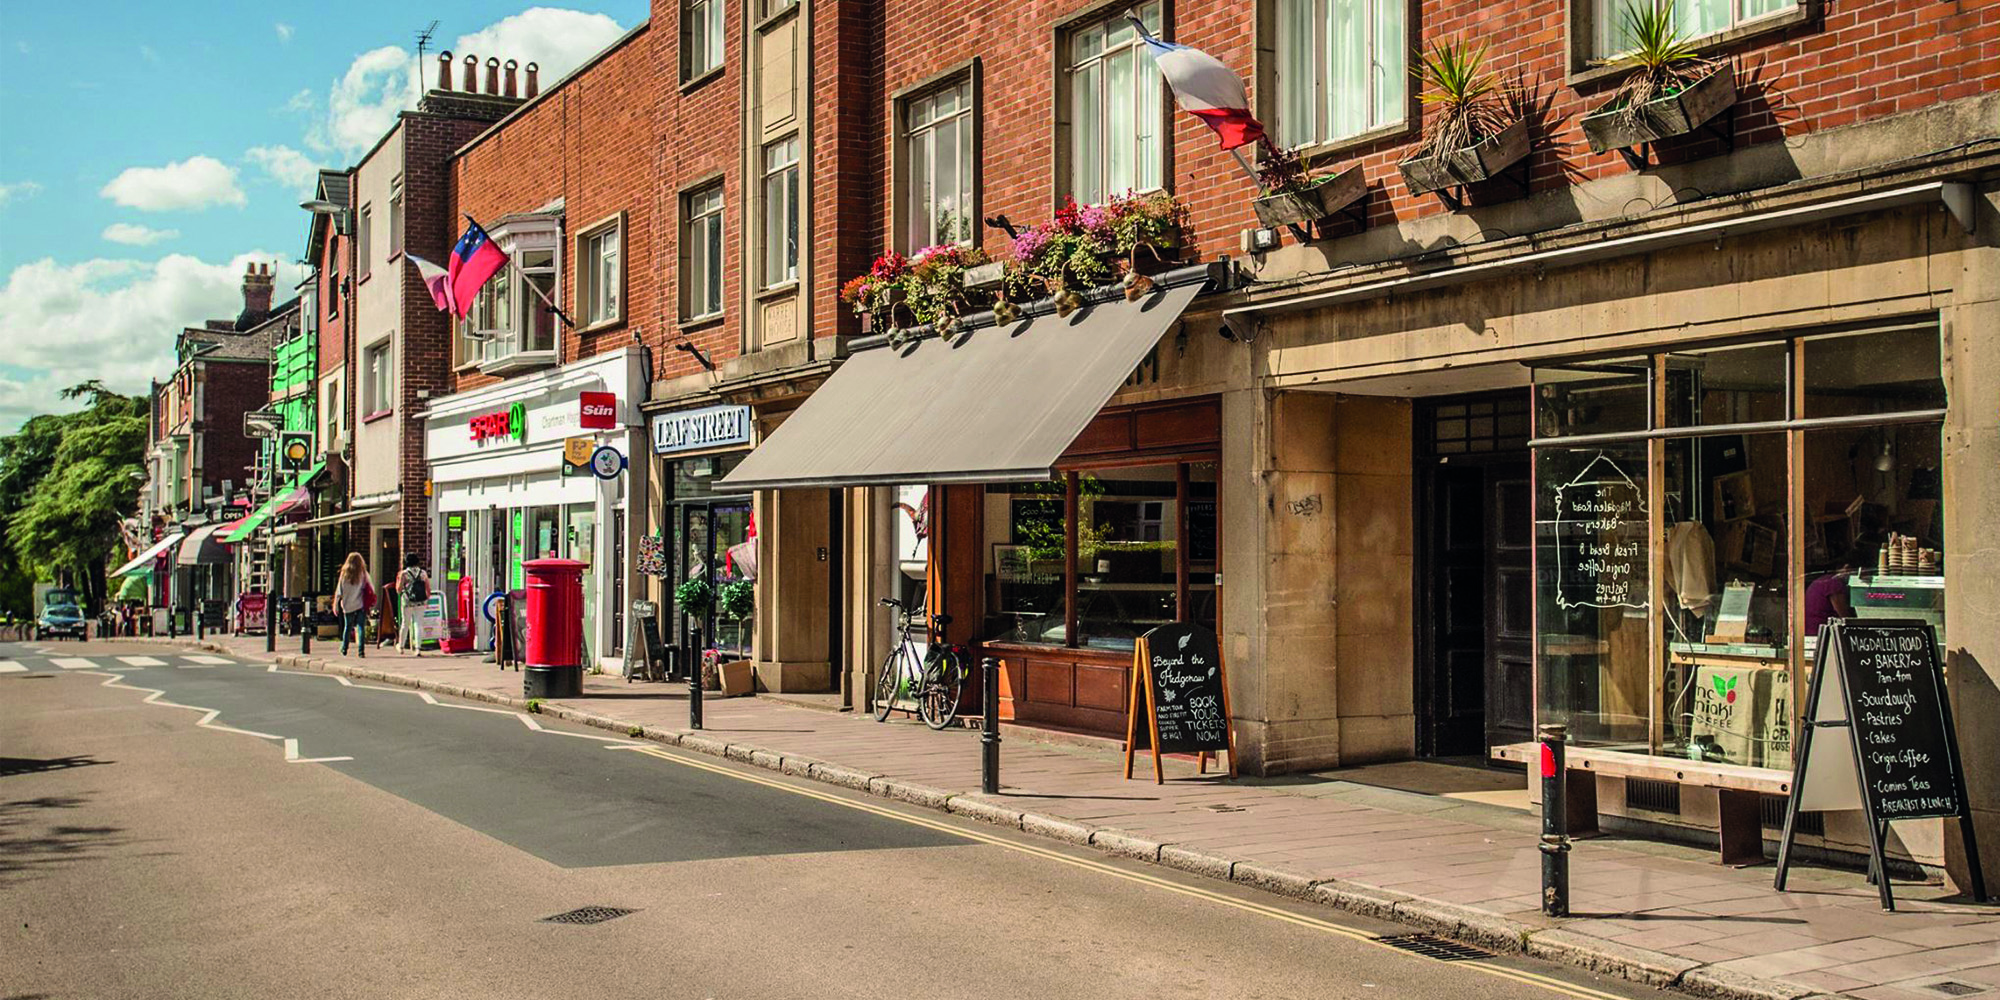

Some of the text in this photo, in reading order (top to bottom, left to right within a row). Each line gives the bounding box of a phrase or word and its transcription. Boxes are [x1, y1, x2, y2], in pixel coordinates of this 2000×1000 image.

[471, 411, 510, 440] SPAR
[657, 408, 744, 447] LEAF STREET
[224, 512, 243, 520] OPEN
[1849, 636, 1922, 652] MAGDALEN ROAD
[1153, 653, 1204, 670] Beyond the
[1875, 653, 1911, 669] BAKERY
[1159, 670, 1204, 687] Hedgerow
[1190, 695, 1217, 708] BOOK
[1190, 707, 1220, 720] YOUR
[1185, 719, 1226, 730] TICKETS
[1898, 748, 1930, 768] Coffee
[1908, 775, 1931, 791] Teas
[1927, 796, 1953, 809] LUNCH
